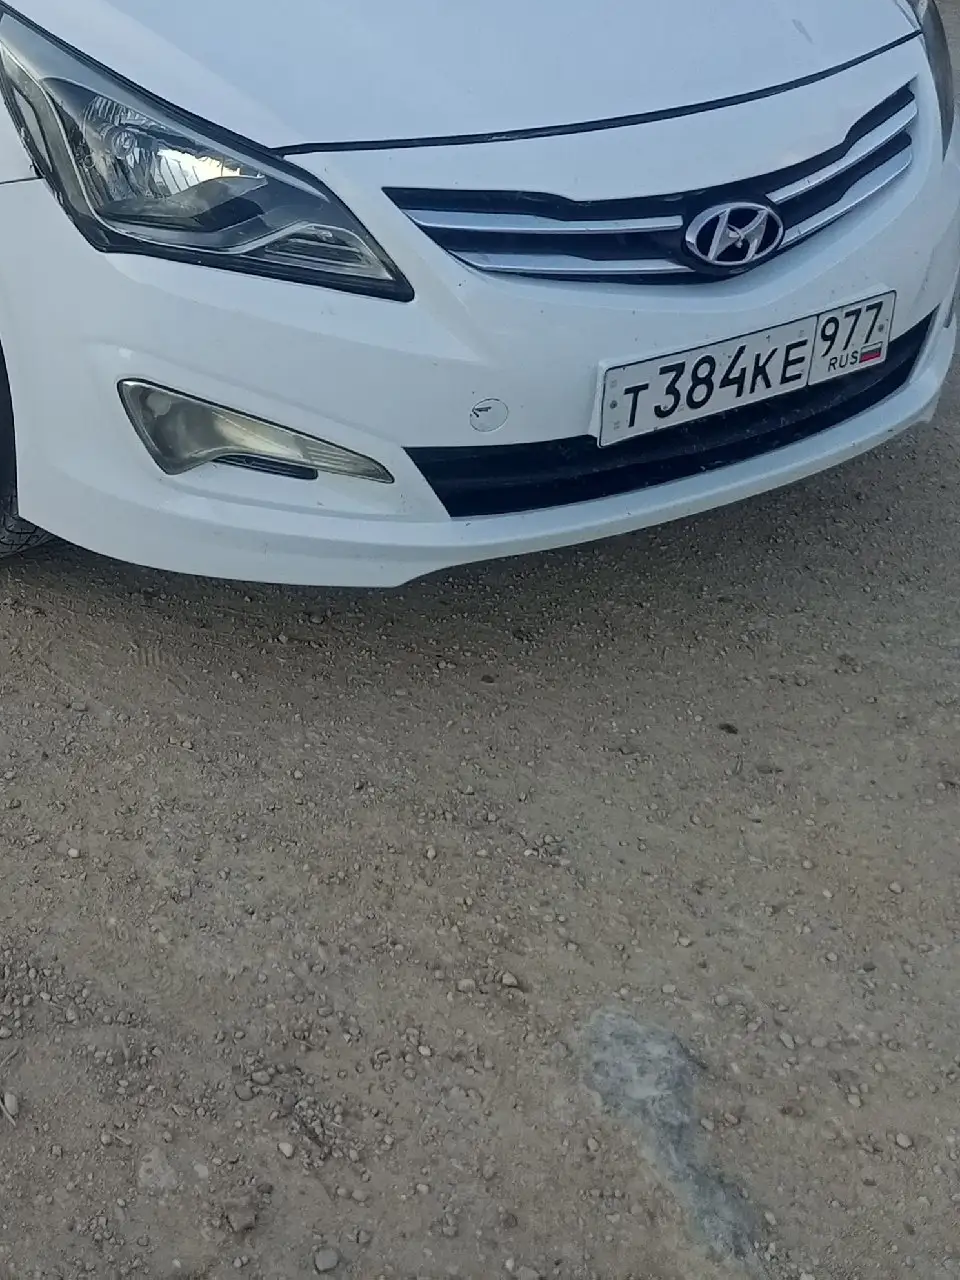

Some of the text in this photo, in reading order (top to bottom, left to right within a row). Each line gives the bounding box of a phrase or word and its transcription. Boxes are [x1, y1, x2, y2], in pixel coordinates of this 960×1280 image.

[623, 301, 884, 429] T384KE 977
[828, 350, 859, 372] RUS
